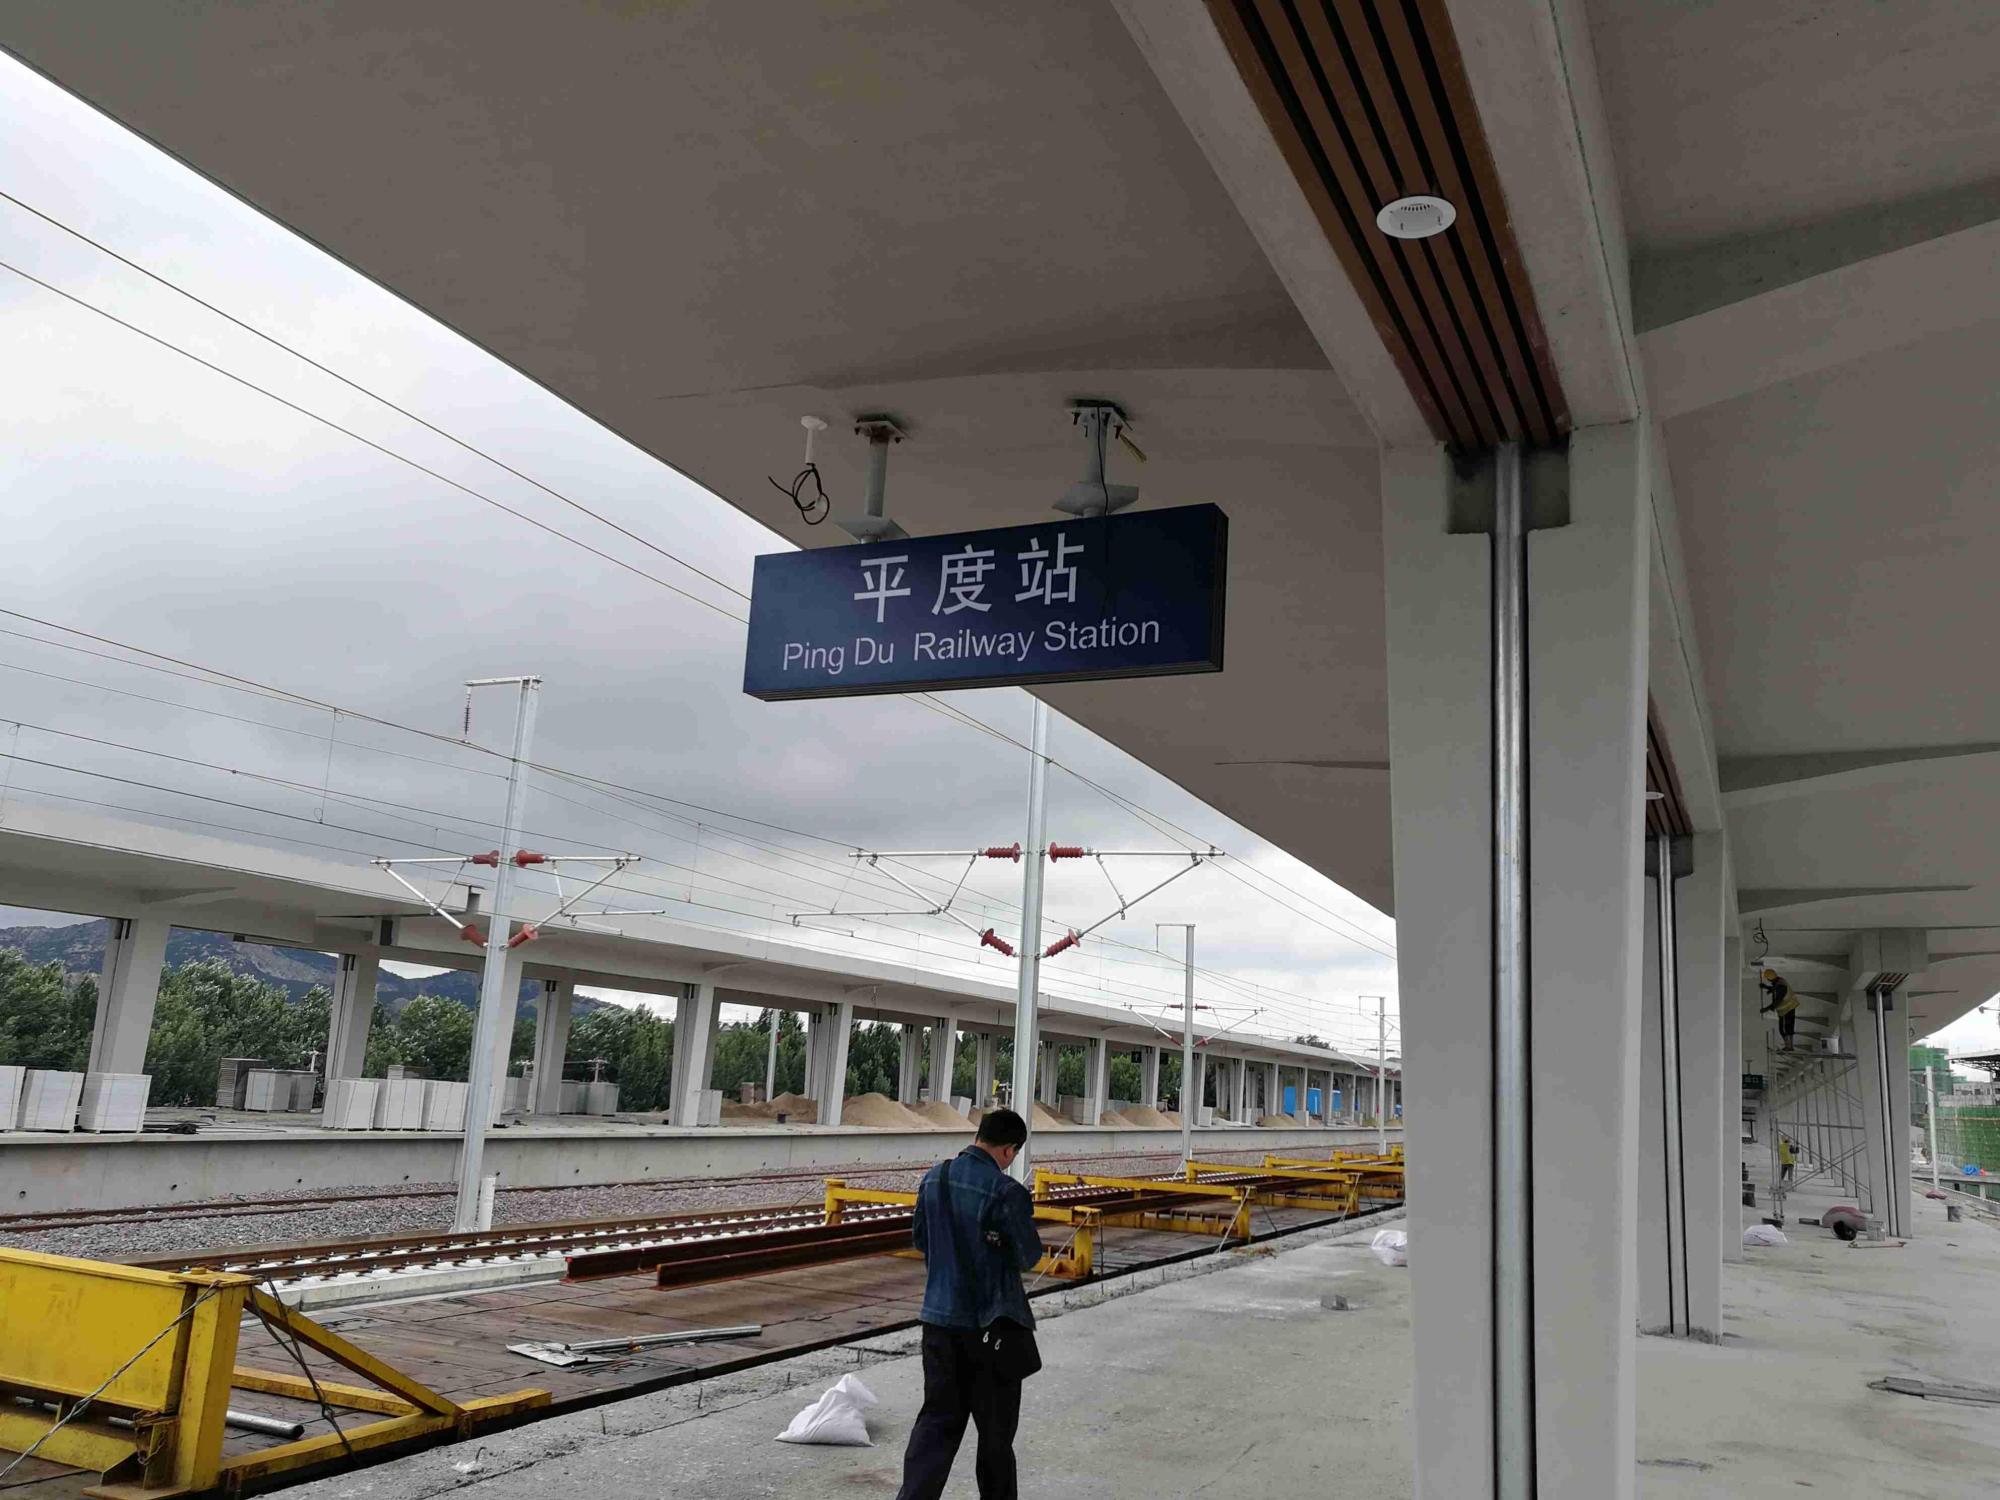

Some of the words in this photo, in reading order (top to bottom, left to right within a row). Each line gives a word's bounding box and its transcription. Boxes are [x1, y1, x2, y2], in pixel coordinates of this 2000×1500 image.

[854, 532, 1084, 623] 平度站
[783, 642, 844, 675] Ping
[854, 637, 894, 665] Du
[913, 626, 1035, 662] Railway
[1044, 616, 1160, 652] Station
